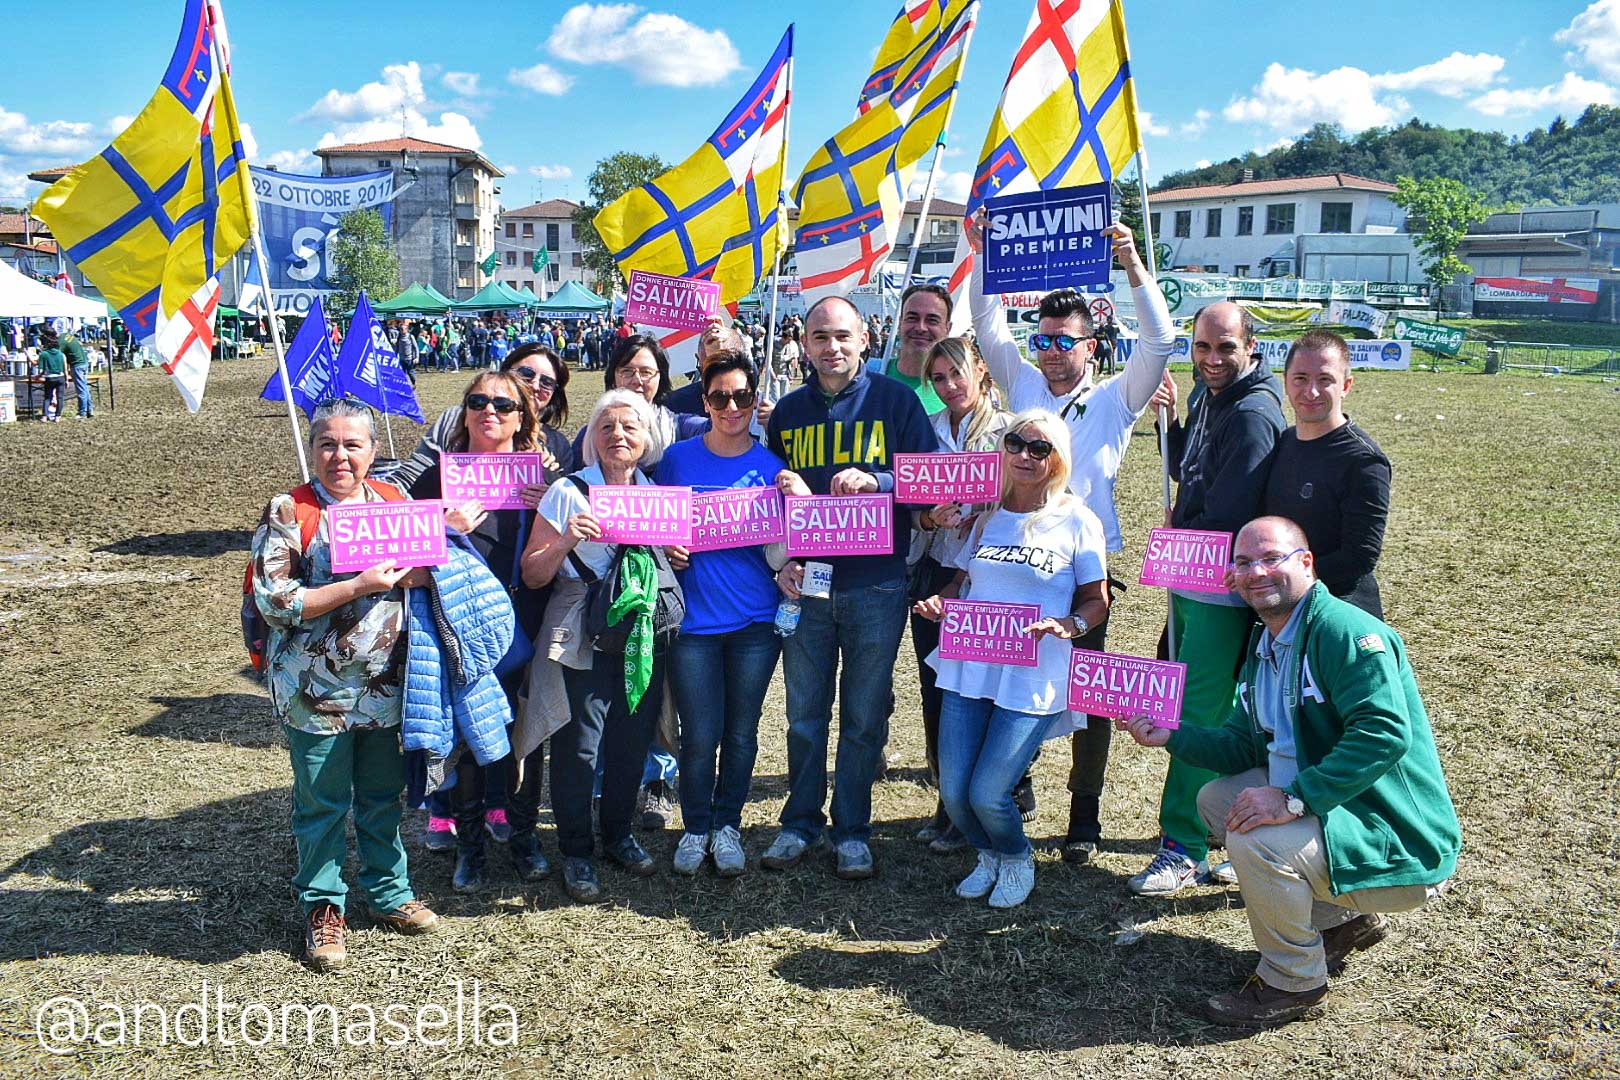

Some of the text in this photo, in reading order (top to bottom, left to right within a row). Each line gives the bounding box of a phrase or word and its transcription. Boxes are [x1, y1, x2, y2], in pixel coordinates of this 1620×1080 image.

[252, 177, 392, 207] 22 OTTOBRE 2017
[990, 203, 1104, 241] SALVINI
[1000, 236, 1093, 256] PREMIER
[636, 275, 664, 285] DONNE
[662, 279, 695, 290] EMILIANE
[632, 282, 716, 312] SALVINI
[1012, 294, 1041, 307] DELLA
[1489, 290, 1534, 298] LOMBARDIA
[639, 304, 706, 322] PREMIER
[1357, 344, 1382, 352] SALVINI
[447, 456, 474, 464] DONNE
[475, 456, 511, 464] EMILIANE
[447, 464, 537, 485] SALVINI
[899, 463, 995, 483] SALVINI
[456, 487, 519, 497] PREMIE
[910, 484, 985, 494] PREMIER
[715, 493, 749, 503] EMILIANE
[792, 500, 821, 508] DONNE
[822, 499, 859, 507] EMILIANE
[336, 509, 369, 518] DONNE
[370, 506, 411, 516] EMILIANE
[596, 498, 687, 520] SALVINI
[692, 498, 777, 528] SALVINI
[606, 520, 679, 532] PREMIER
[790, 506, 886, 531] SALVINI
[335, 513, 439, 543] SALVINI
[699, 521, 770, 539] PREMIER
[801, 531, 877, 543] PREMIER
[1176, 534, 1204, 543] EMILIANE
[348, 540, 432, 557] PREMIER
[1148, 541, 1224, 567] SALVINI
[1152, 563, 1215, 579] PREMIER
[947, 604, 974, 612] DONNE
[975, 605, 1009, 615] EMILIANE
[944, 612, 1033, 639] SALVINI
[953, 636, 1024, 652] PREMIER
[1077, 655, 1107, 665] DONNE
[1109, 659, 1149, 671] EMILIANE
[1073, 663, 1177, 699] SALVINI
[1083, 690, 1164, 712] PREMIER
